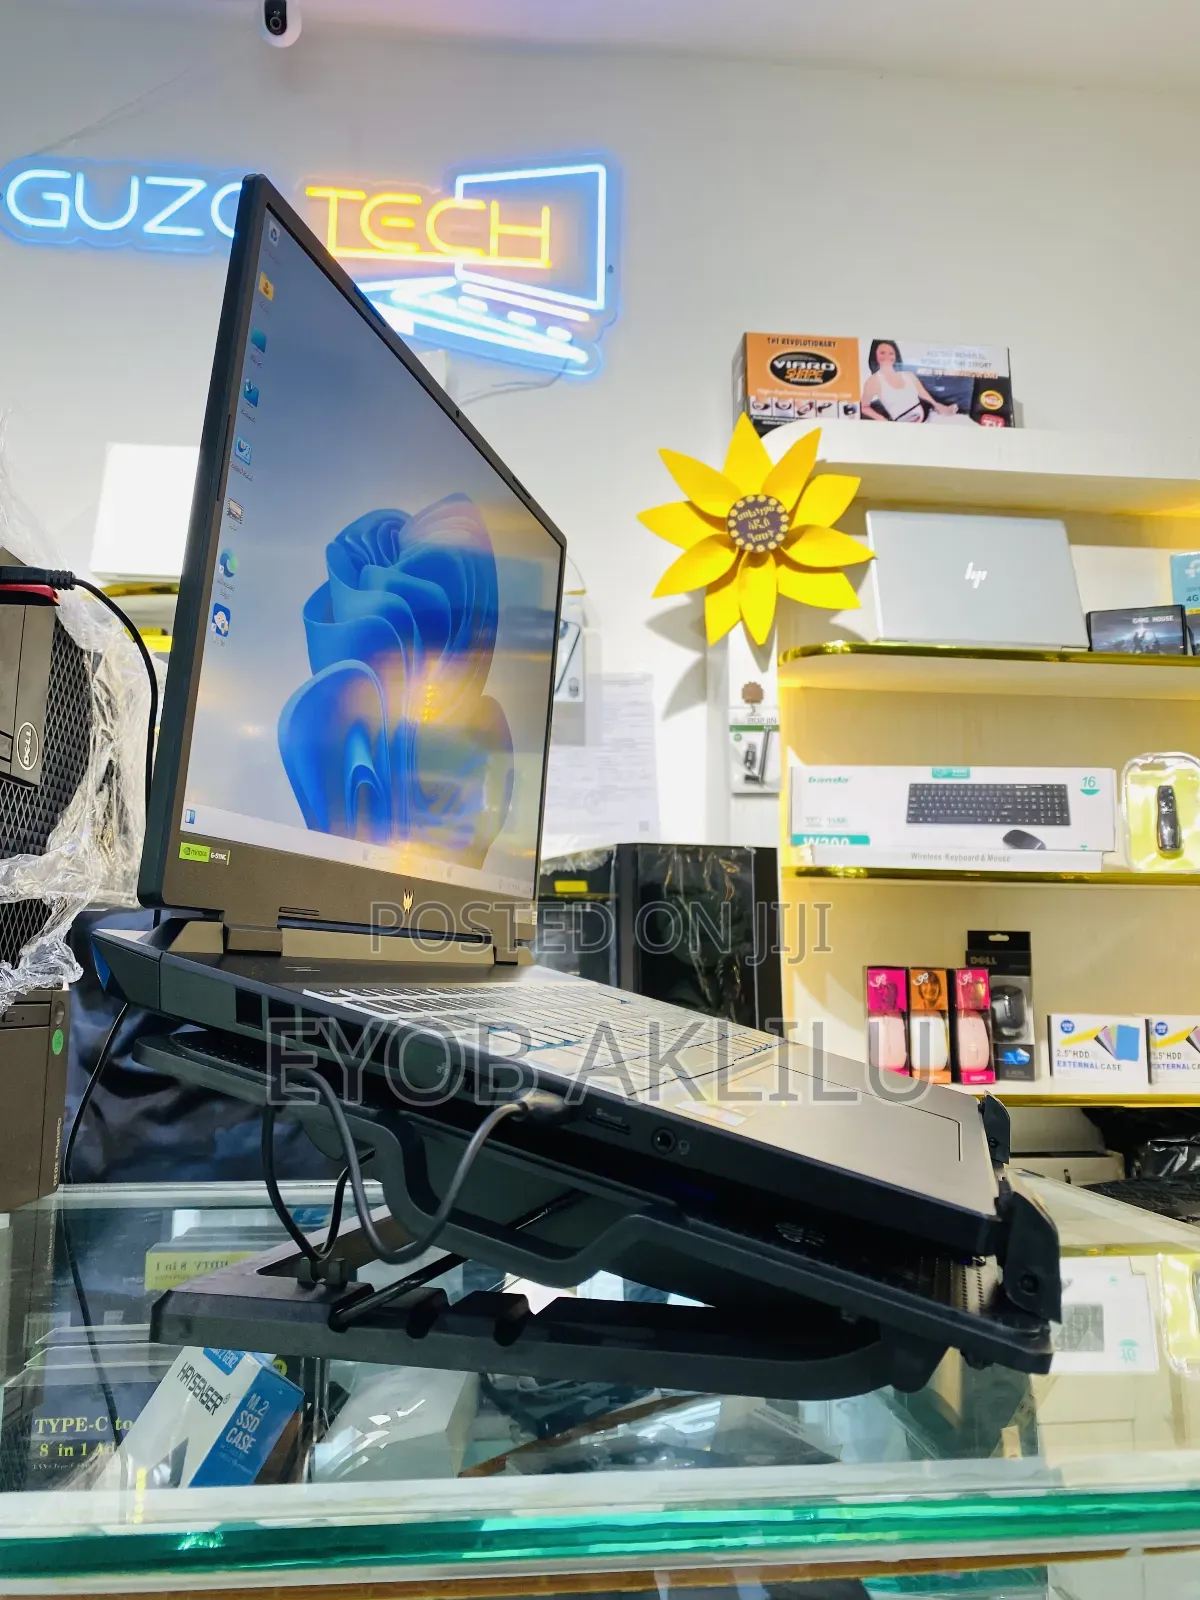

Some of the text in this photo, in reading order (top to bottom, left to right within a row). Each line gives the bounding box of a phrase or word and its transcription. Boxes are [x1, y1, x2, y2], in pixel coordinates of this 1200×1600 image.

[305, 186, 551, 266] TECH
[781, 338, 837, 348] REVOLUTIONARY
[772, 360, 836, 371] VIBRO
[1152, 615, 1174, 623] MOUSE
[1082, 775, 1097, 788] 16
[910, 852, 943, 861] Wireless
[945, 852, 980, 863] Keyboard
[987, 854, 1011, 863] Mouse
[1072, 1050, 1090, 1059] HDD
[1166, 1052, 1182, 1060] HDD
[1056, 1060, 1122, 1072] EXTERNAL CASE
[1151, 1063, 1190, 1071] EXTERNAL
[246, 1393, 270, 1416] M.2
[34, 1416, 134, 1434] TYPE-C to
[236, 1409, 260, 1433] SSD
[225, 1427, 257, 1454] CASE
[40, 1442, 49, 1457] 8
[57, 1443, 74, 1457] in
[80, 1442, 88, 1456] 1
